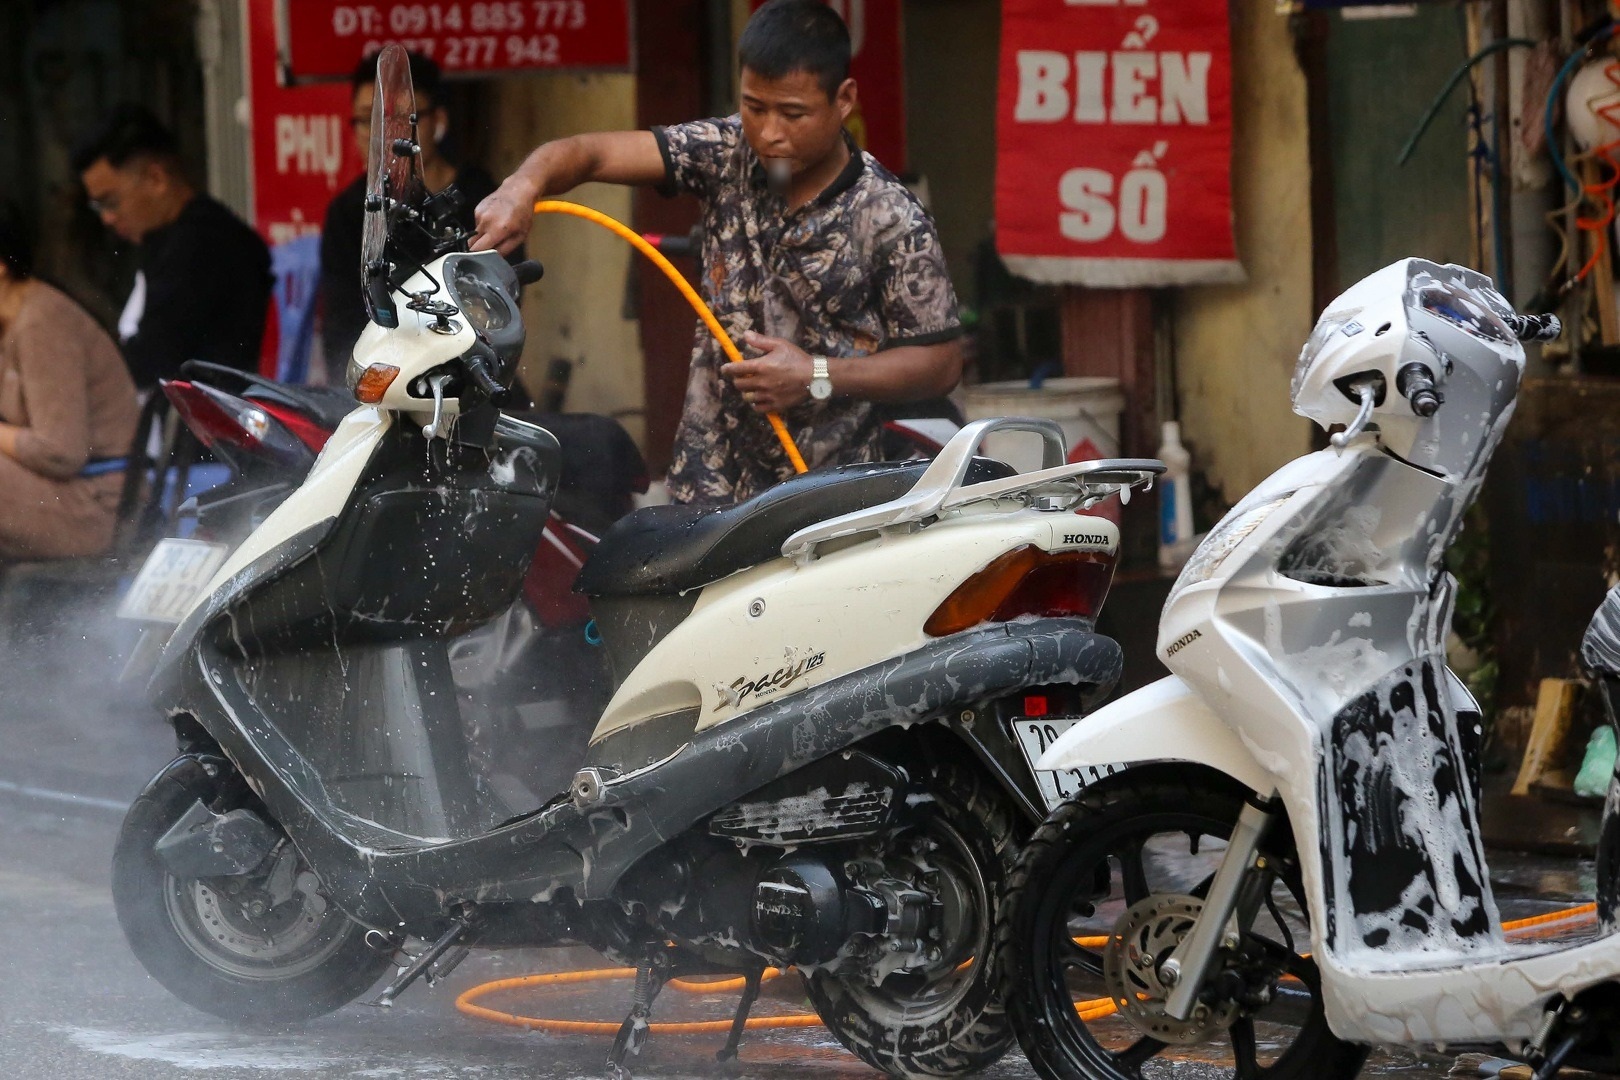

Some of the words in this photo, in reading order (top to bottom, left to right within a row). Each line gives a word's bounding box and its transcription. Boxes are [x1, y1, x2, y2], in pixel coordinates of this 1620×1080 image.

[333, 5, 382, 36] ĐT:
[389, 4, 463, 35] 0914
[470, 3, 525, 32] 885
[533, 0, 587, 30] 773
[445, 36, 498, 66] 277
[505, 34, 560, 64] 942
[1014, 14, 1212, 125] BIỂN
[275, 113, 342, 191] PHỤ
[1058, 141, 1169, 243] SỐ
[1063, 534, 1109, 545] HONDA
[1166, 629, 1202, 658] HONDA
[713, 658, 807, 712] Spacy
[805, 651, 825, 670] 125
[755, 687, 778, 699] HONDA
